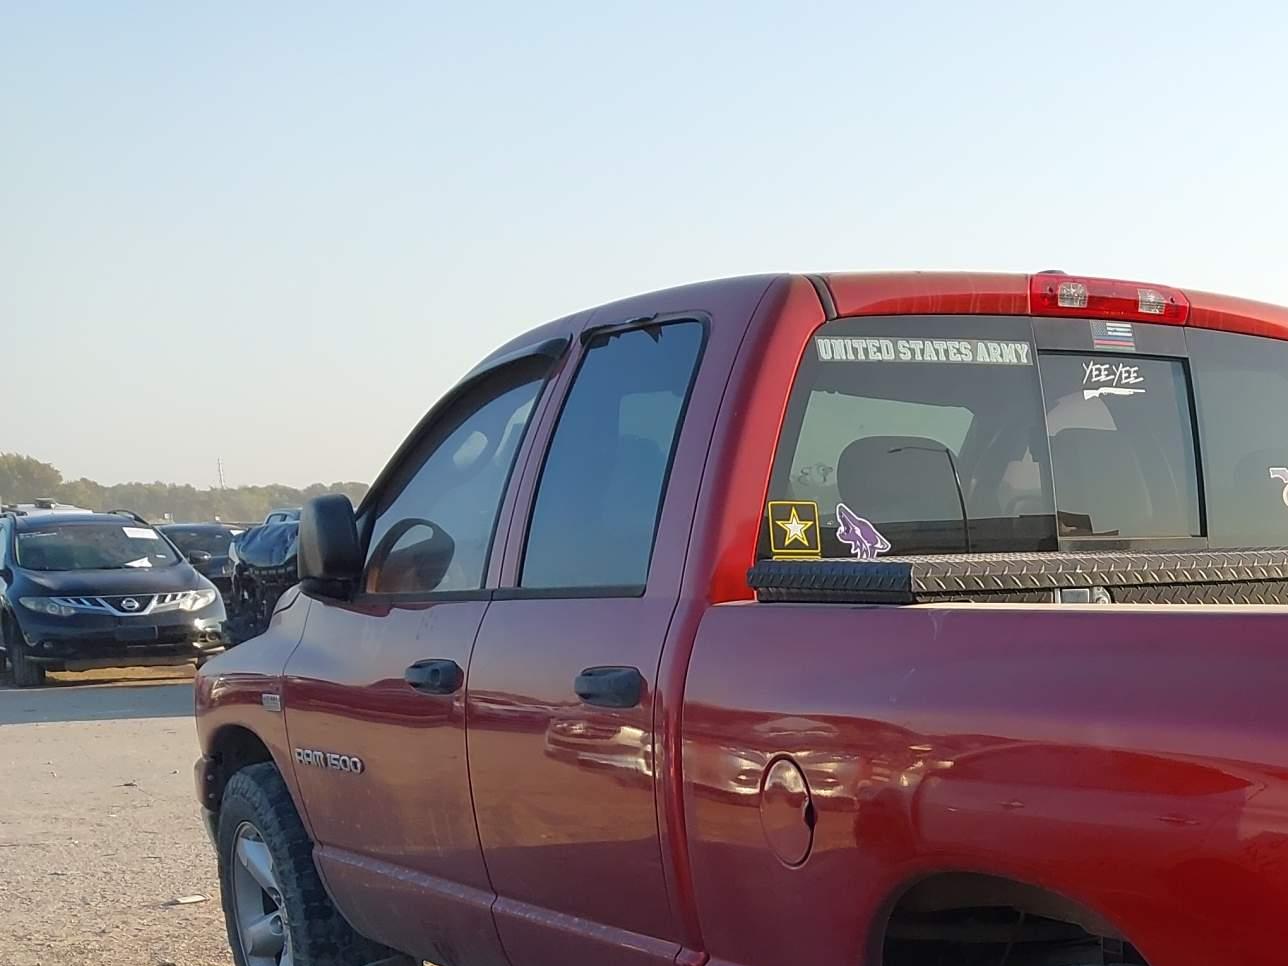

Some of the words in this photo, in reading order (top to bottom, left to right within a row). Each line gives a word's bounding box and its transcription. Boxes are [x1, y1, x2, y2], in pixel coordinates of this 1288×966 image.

[817, 338, 895, 361] UNITED
[898, 340, 973, 362] STATES
[977, 342, 1028, 363] ARMY
[1082, 360, 1114, 384] YEE
[1112, 363, 1144, 386] YEE
[295, 748, 325, 768] RAM
[327, 753, 361, 774] 1500
